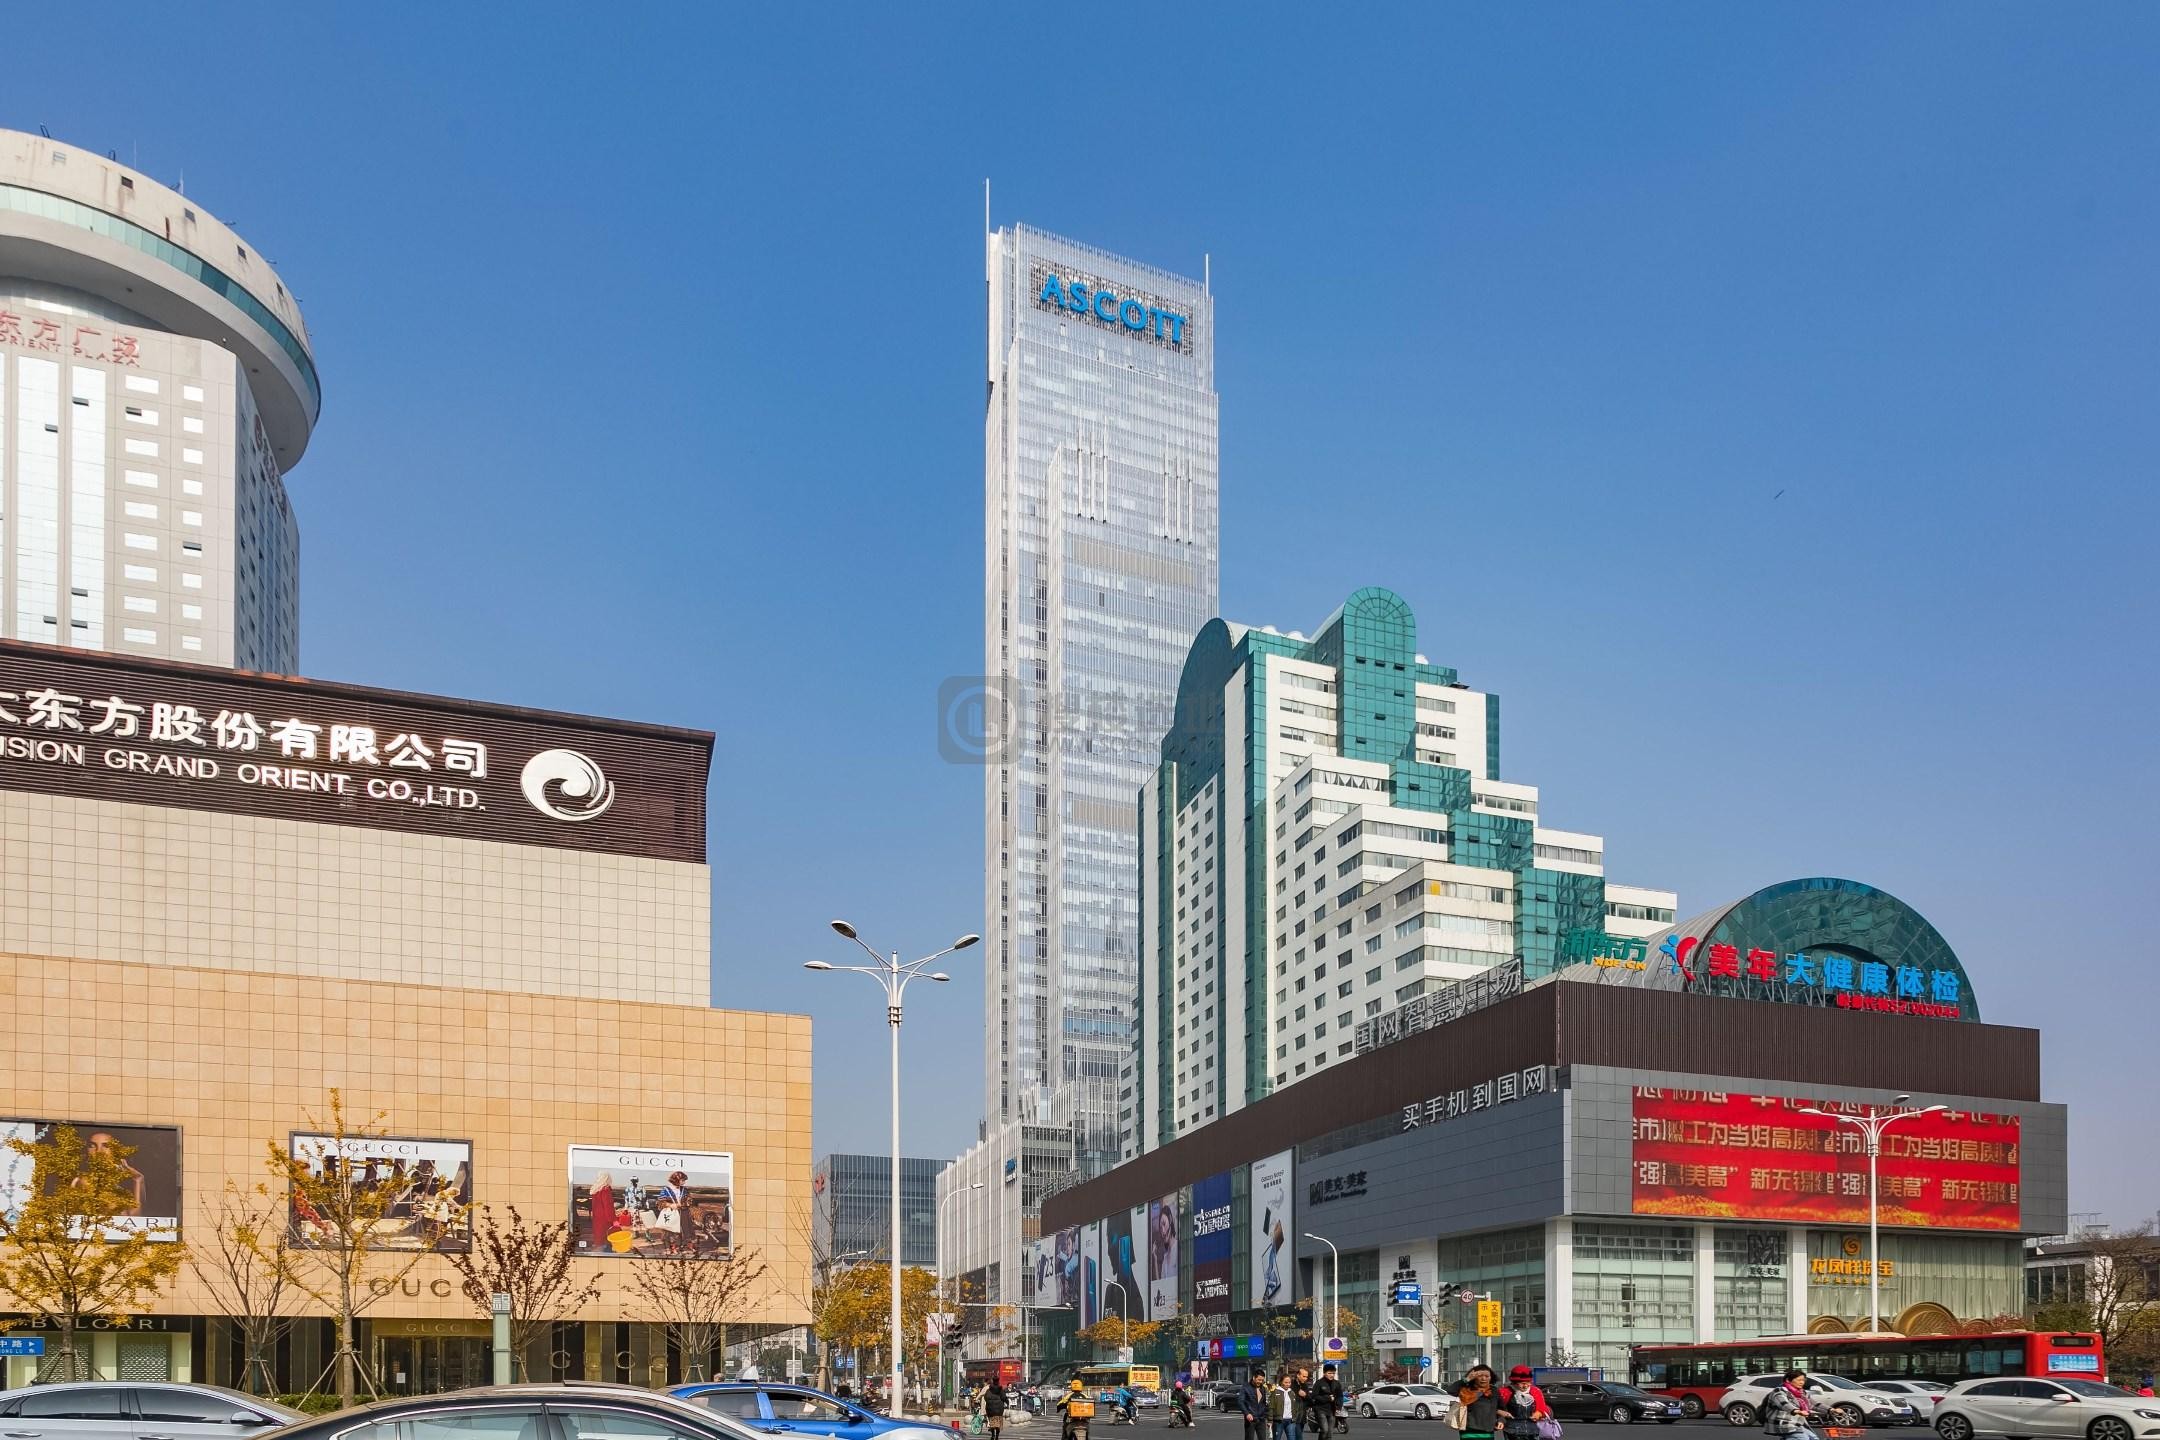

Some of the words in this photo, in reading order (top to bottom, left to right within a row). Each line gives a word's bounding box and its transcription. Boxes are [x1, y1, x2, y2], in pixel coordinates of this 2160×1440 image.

[1040, 273, 1185, 344] ASCOTT
[72, 347, 140, 367] PLAZA
[104, 748, 220, 779] GRAND
[238, 763, 352, 795] ORIENT
[1708, 943, 1960, 1003] 美年大健康体检
[1356, 959, 1521, 1051] 国网智慧广场
[1403, 1064, 1546, 1130] 买手机到国网
[347, 1142, 419, 1155] GUCCI
[619, 1156, 684, 1168] GUCCI
[1462, 1292, 1472, 1300] 40
[406, 1323, 468, 1333] GUCCI
